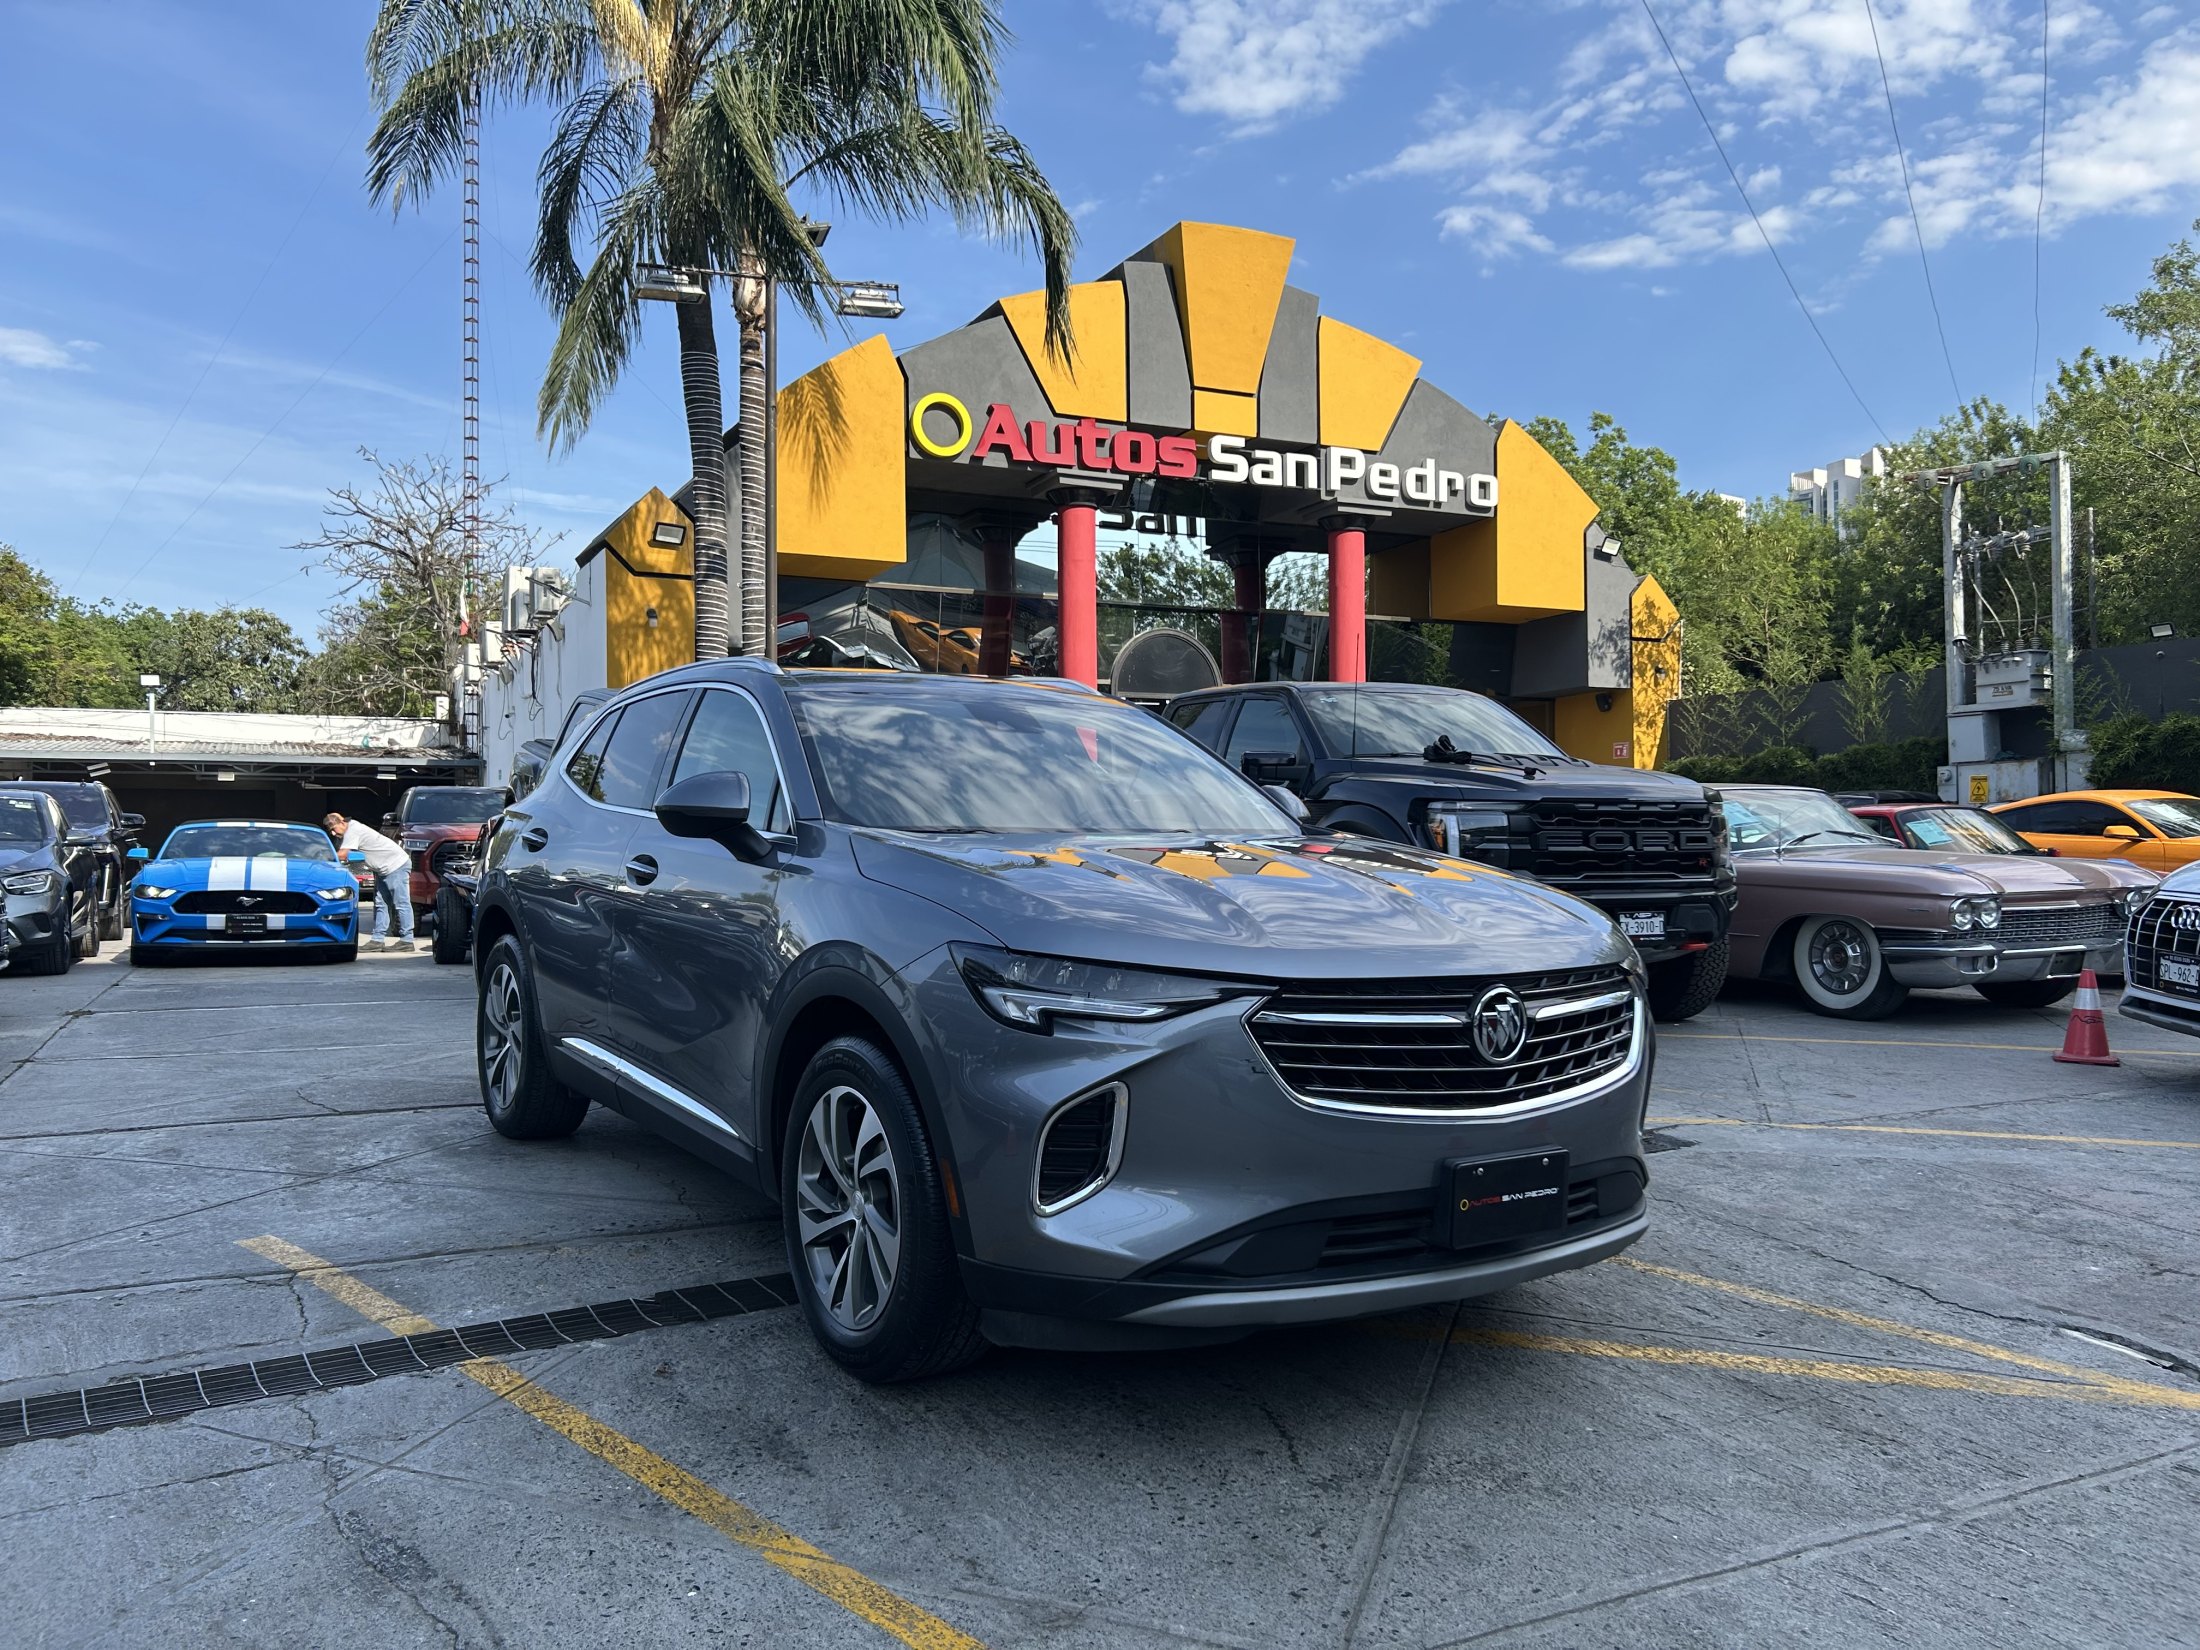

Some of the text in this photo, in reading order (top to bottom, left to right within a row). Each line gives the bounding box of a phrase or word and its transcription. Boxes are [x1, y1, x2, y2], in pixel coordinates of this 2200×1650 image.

[973, 403, 1198, 479] Autos
[1537, 831, 1714, 850] FORD
[1502, 1193, 1523, 1202] SAN
